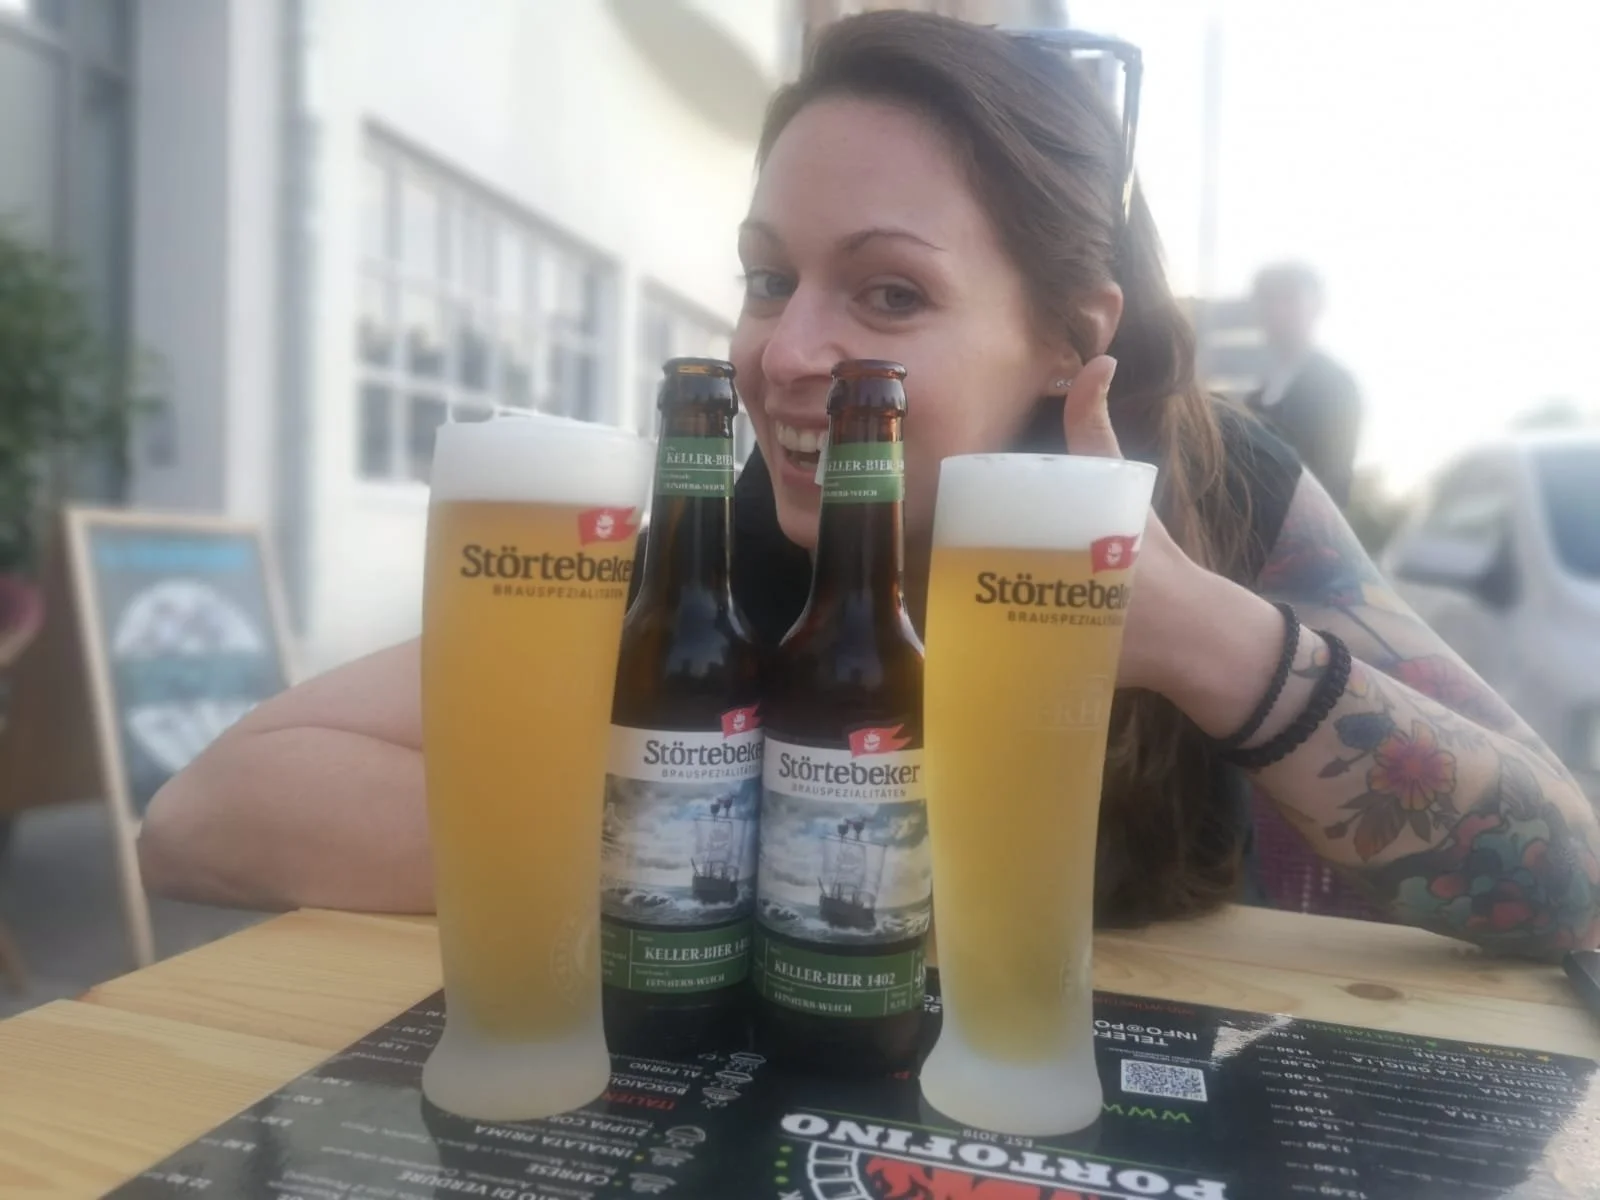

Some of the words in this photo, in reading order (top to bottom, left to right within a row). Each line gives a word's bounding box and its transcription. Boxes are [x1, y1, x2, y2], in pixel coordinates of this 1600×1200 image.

[665, 452, 733, 466] KELLER-BIE
[460, 543, 634, 583] Störtebeke
[643, 739, 764, 767] Störtebeke
[778, 752, 921, 786] Störtebeker
[791, 781, 907, 798] BRAUSPEZIALITÄTEN
[643, 943, 732, 962] KELLER-BIER
[773, 958, 863, 988] KELLER-BIER
[1094, 1019, 1198, 1042] INFO@PO
[609, 1076, 688, 1096] BOSCAIOL
[780, 1113, 1227, 1200] PORTOFINO
[525, 1162, 611, 1187] CAPRESE
